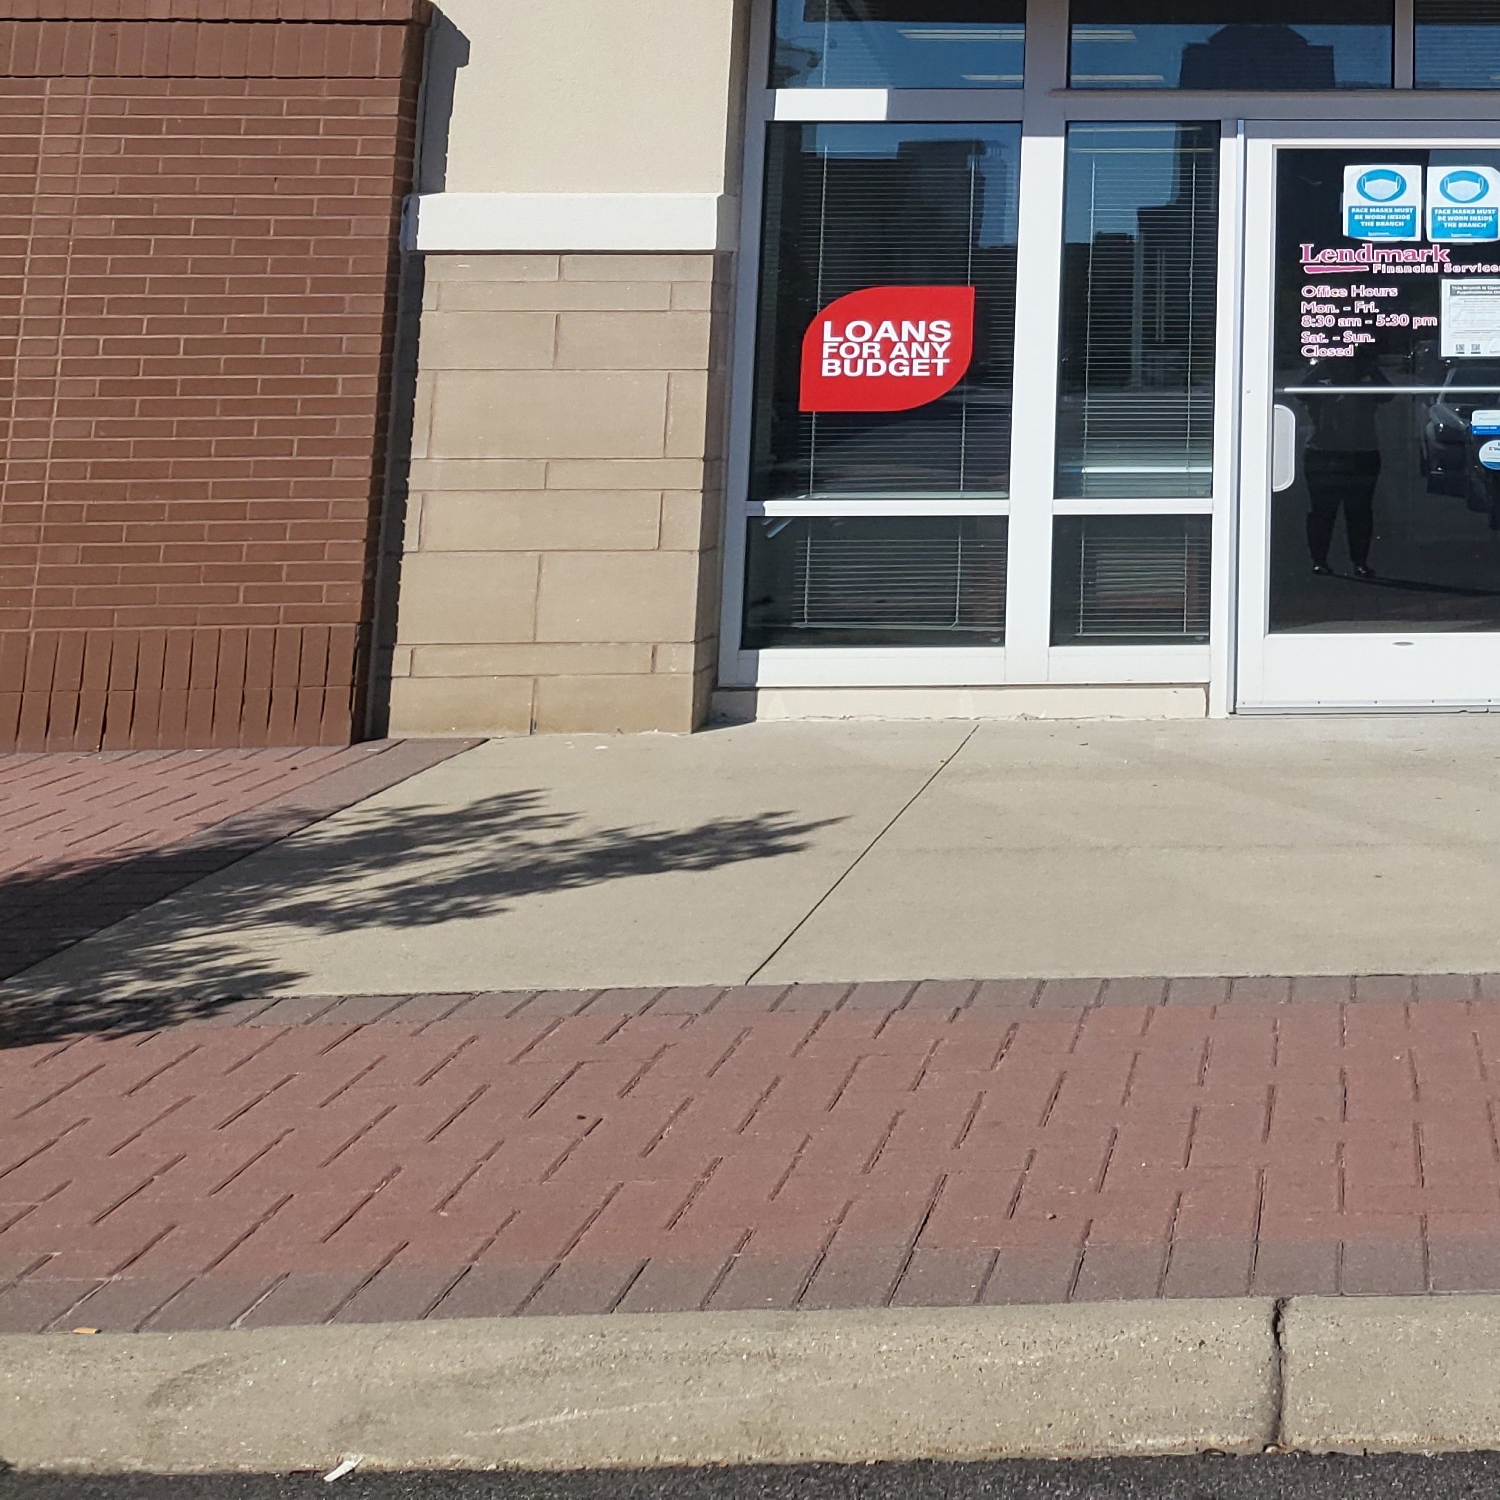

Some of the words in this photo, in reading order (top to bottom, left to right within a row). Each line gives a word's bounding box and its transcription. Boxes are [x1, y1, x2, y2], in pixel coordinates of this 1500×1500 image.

[1299, 243, 1451, 264] Lendmark
[1372, 263, 1439, 275] Financial
[1301, 285, 1348, 297] Office
[1350, 285, 1398, 297] Hours
[1300, 301, 1340, 313] Mon.
[1354, 301, 1380, 313] Fri.
[1300, 315, 1335, 327] 8:30
[1337, 317, 1362, 327] am
[1375, 314, 1410, 327] 5:30
[1412, 315, 1438, 330] pm
[823, 320, 952, 342] LOANS
[1300, 331, 1329, 343] Sat.
[1343, 331, 1375, 343] Sun.
[822, 342, 880, 358] FOR
[889, 342, 950, 358] ANY
[1300, 344, 1354, 357] Closed
[822, 359, 950, 377] BUDGET
